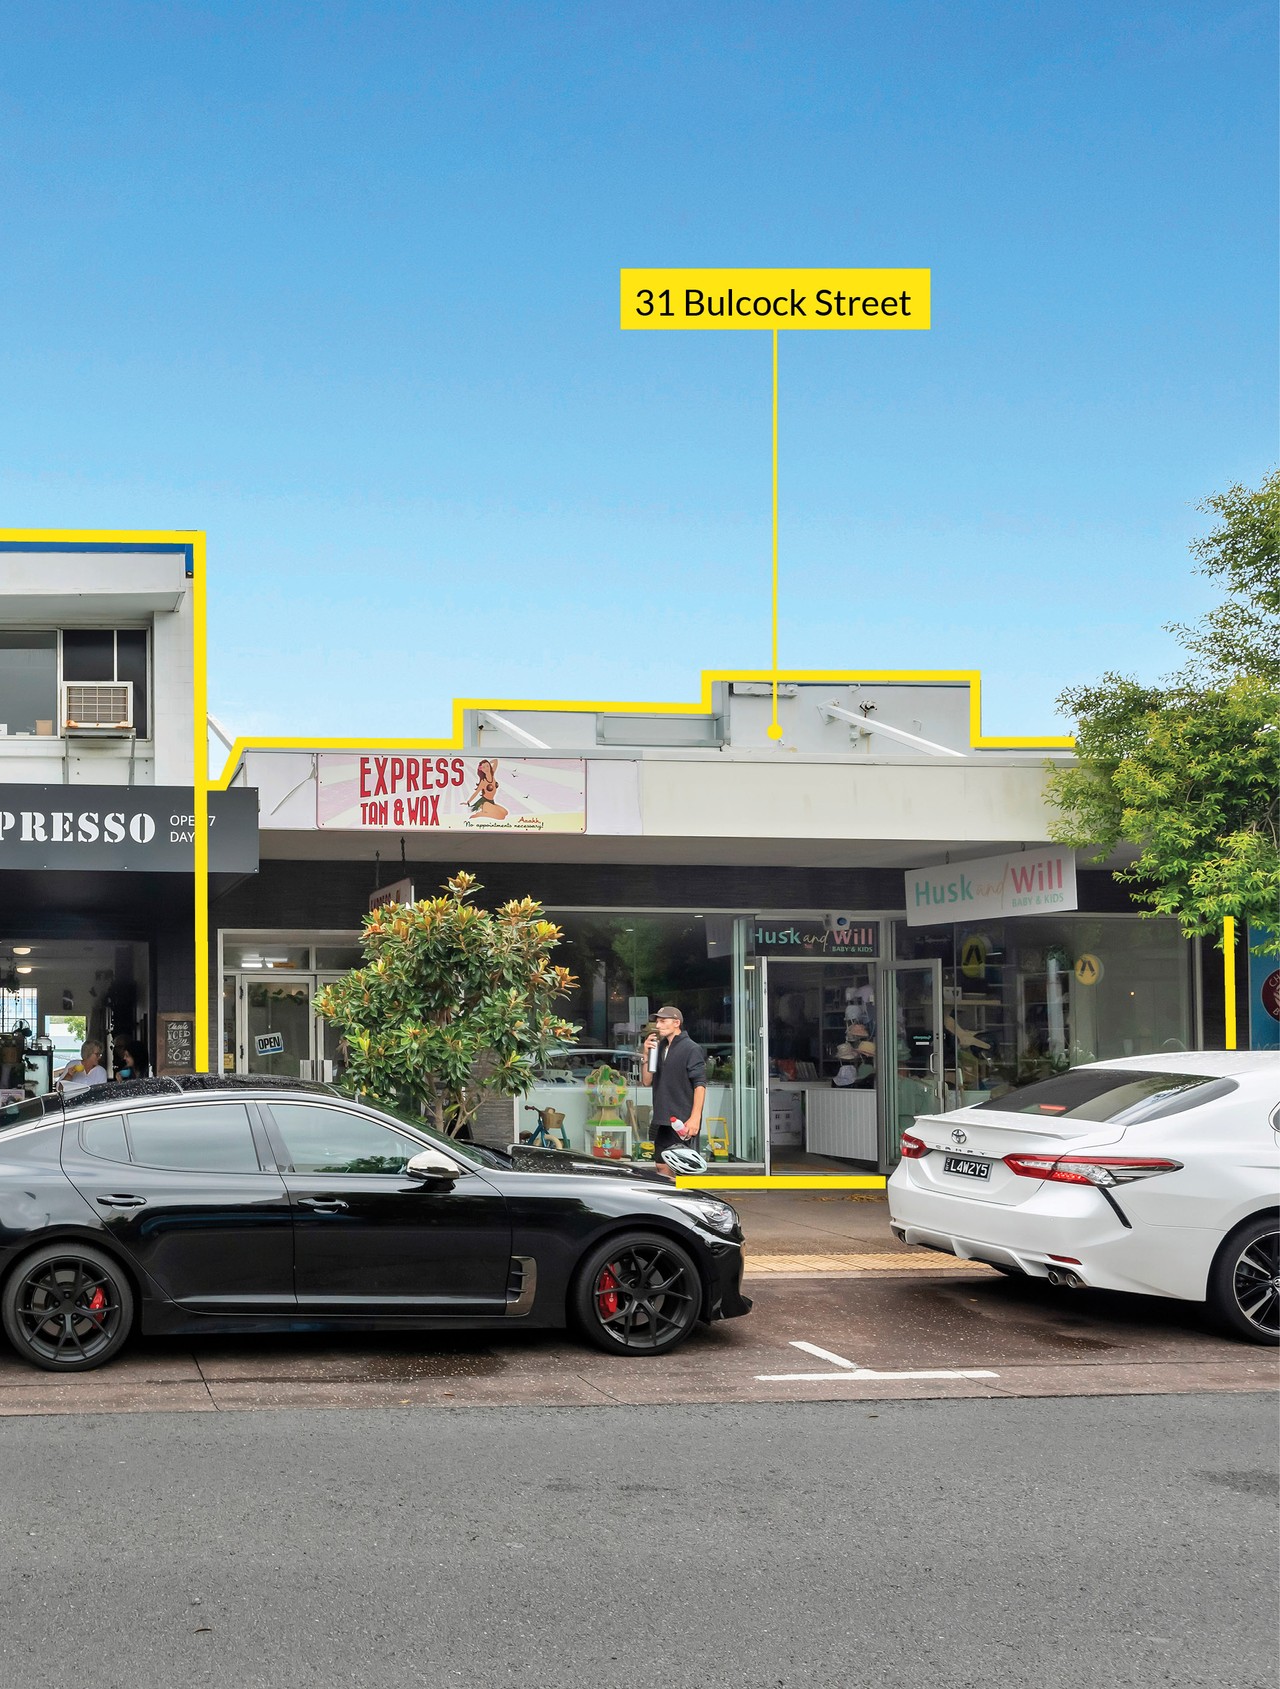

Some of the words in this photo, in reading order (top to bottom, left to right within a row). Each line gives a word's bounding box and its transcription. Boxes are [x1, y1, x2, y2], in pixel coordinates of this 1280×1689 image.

[359, 756, 464, 798] EXPRESS
[360, 800, 388, 826] TAN
[394, 798, 404, 826] &
[407, 794, 440, 826] WAX
[170, 815, 196, 827] OPE
[208, 815, 216, 827] 7
[915, 873, 974, 907] Husk
[975, 861, 1010, 910] and
[1010, 858, 1063, 894] Will
[1011, 896, 1033, 908] BABY
[1035, 896, 1041, 905] &
[1044, 892, 1064, 904] KIDS
[749, 927, 801, 944] Husk
[803, 930, 830, 952] and
[832, 929, 873, 945] Will
[258, 1036, 281, 1050] OPEN
[950, 1159, 988, 1177] L4W2Y5
